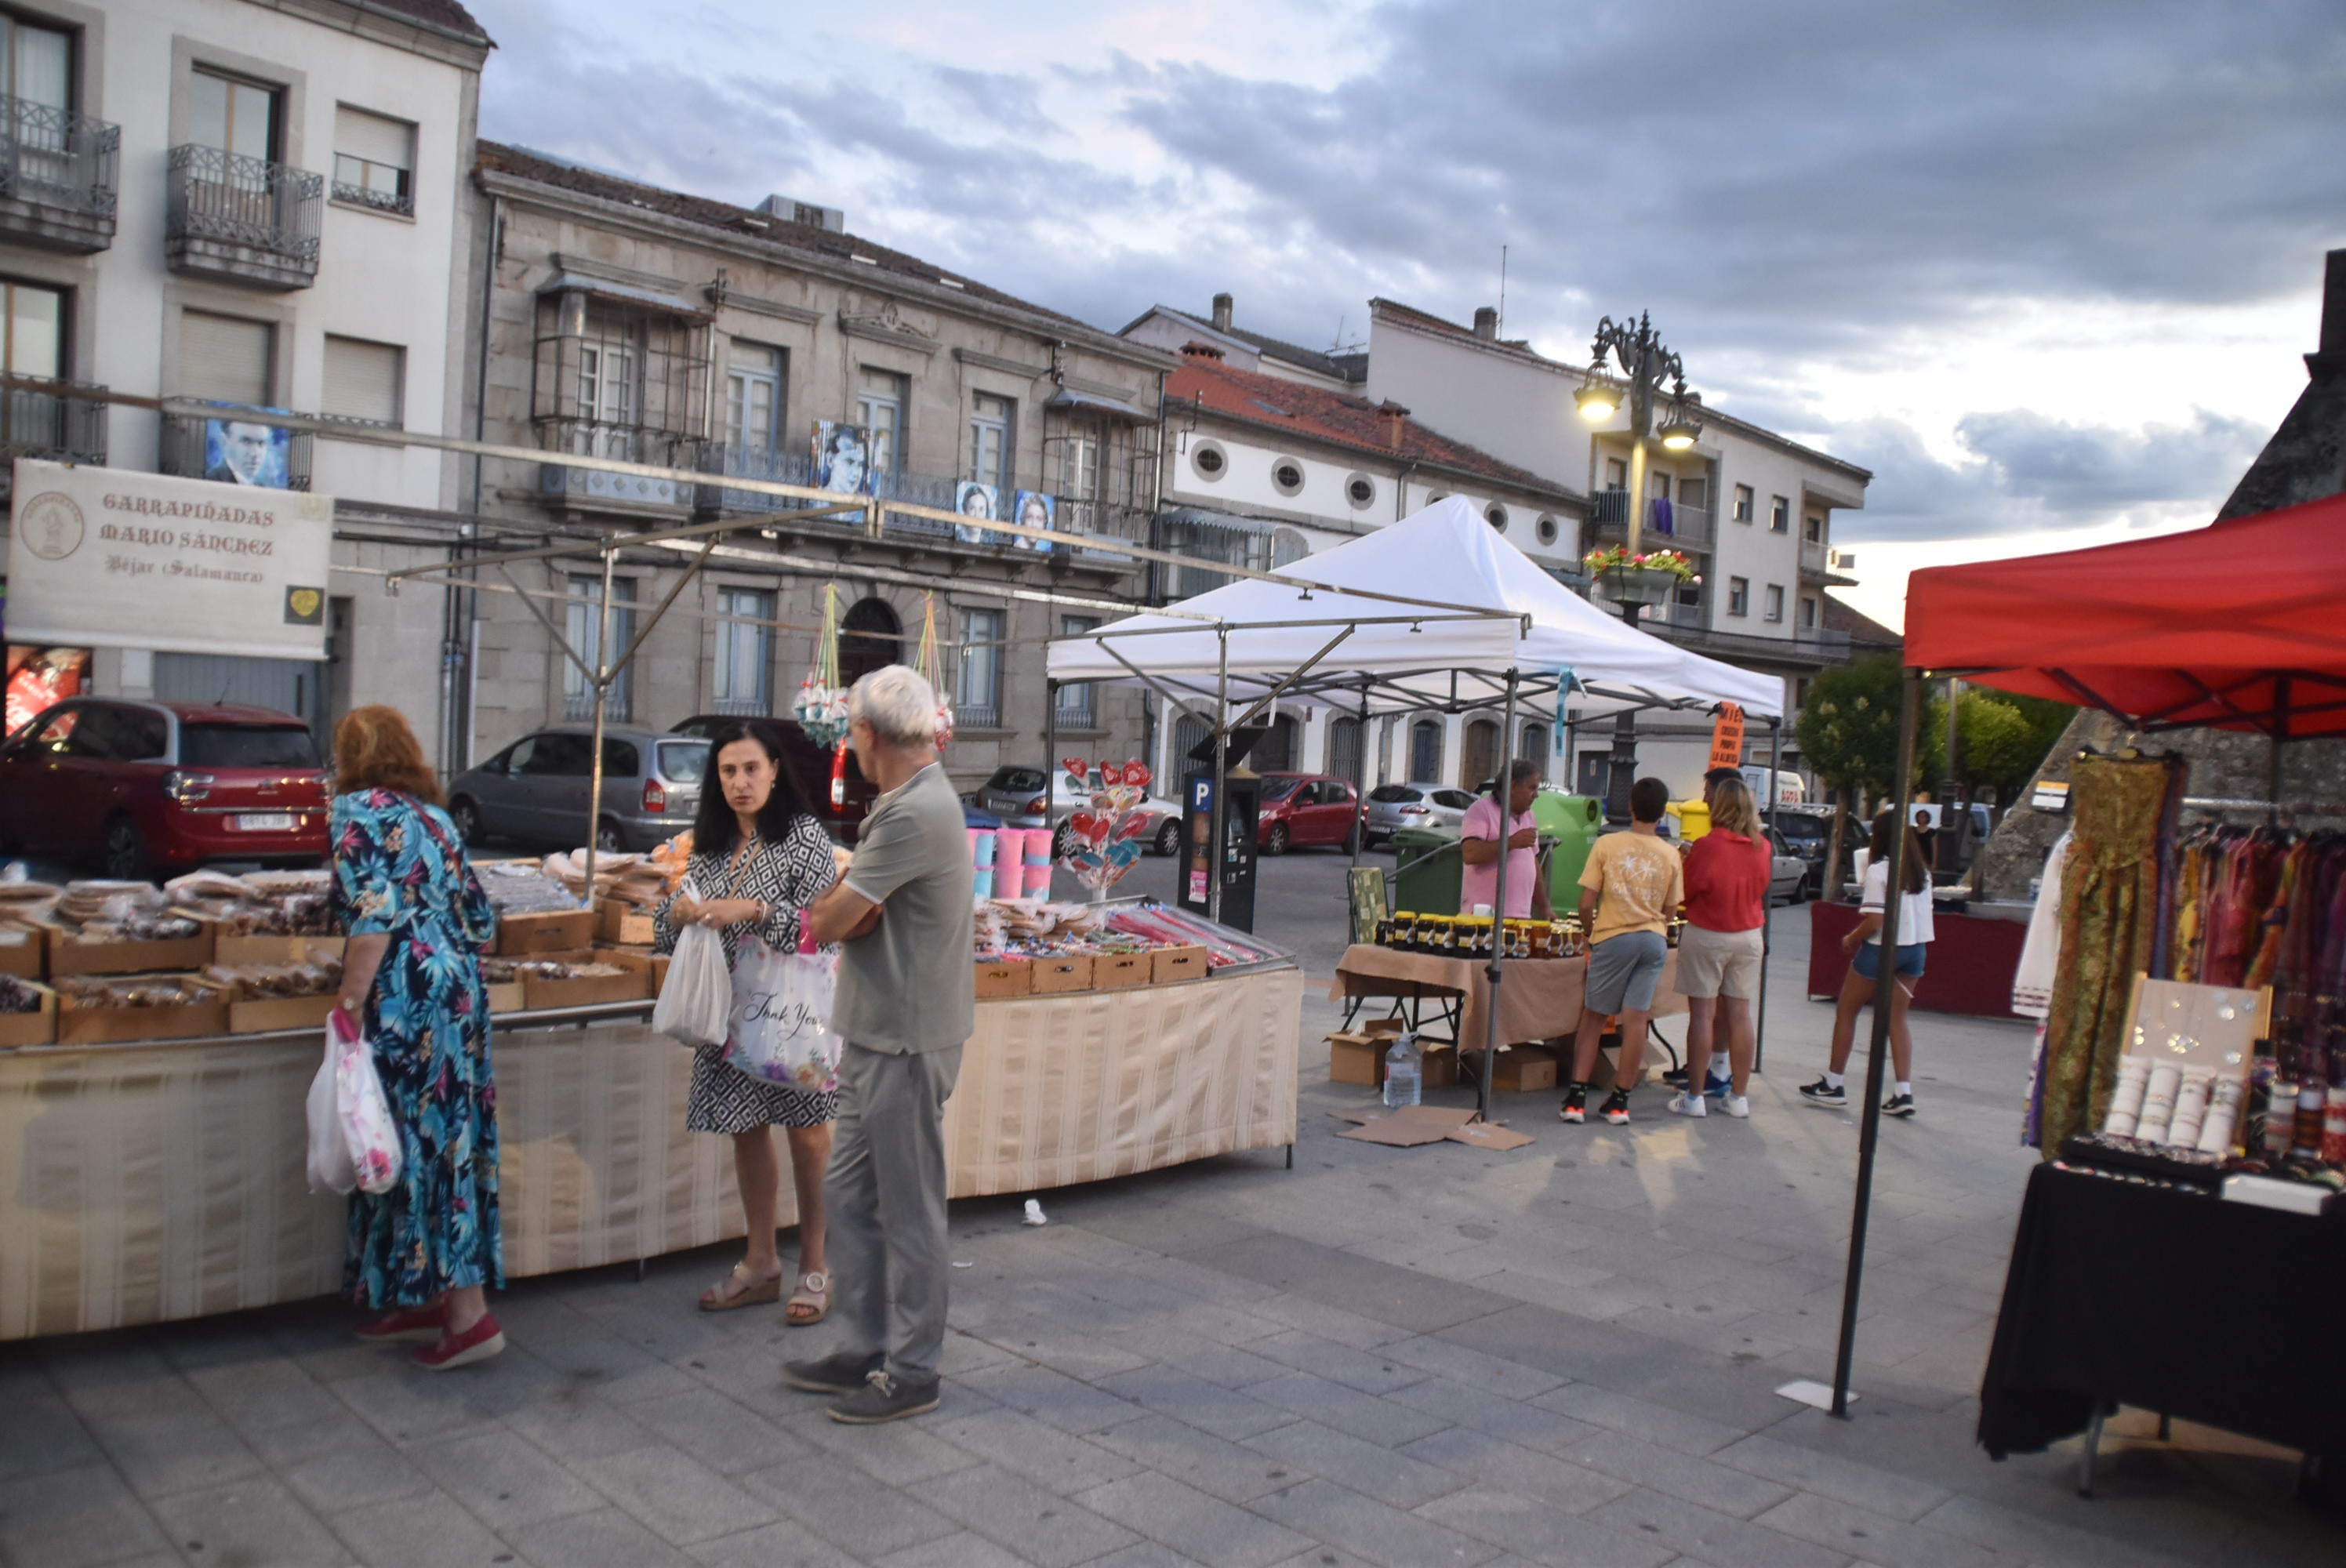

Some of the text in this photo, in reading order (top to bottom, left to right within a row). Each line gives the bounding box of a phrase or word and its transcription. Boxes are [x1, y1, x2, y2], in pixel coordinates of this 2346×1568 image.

[103, 492, 275, 527] GARRAPIÑADAS
[100, 524, 175, 547] MARIO
[105, 554, 154, 577] Béjar
[1196, 782, 1209, 806] P
[777, 1001, 823, 1041] You
